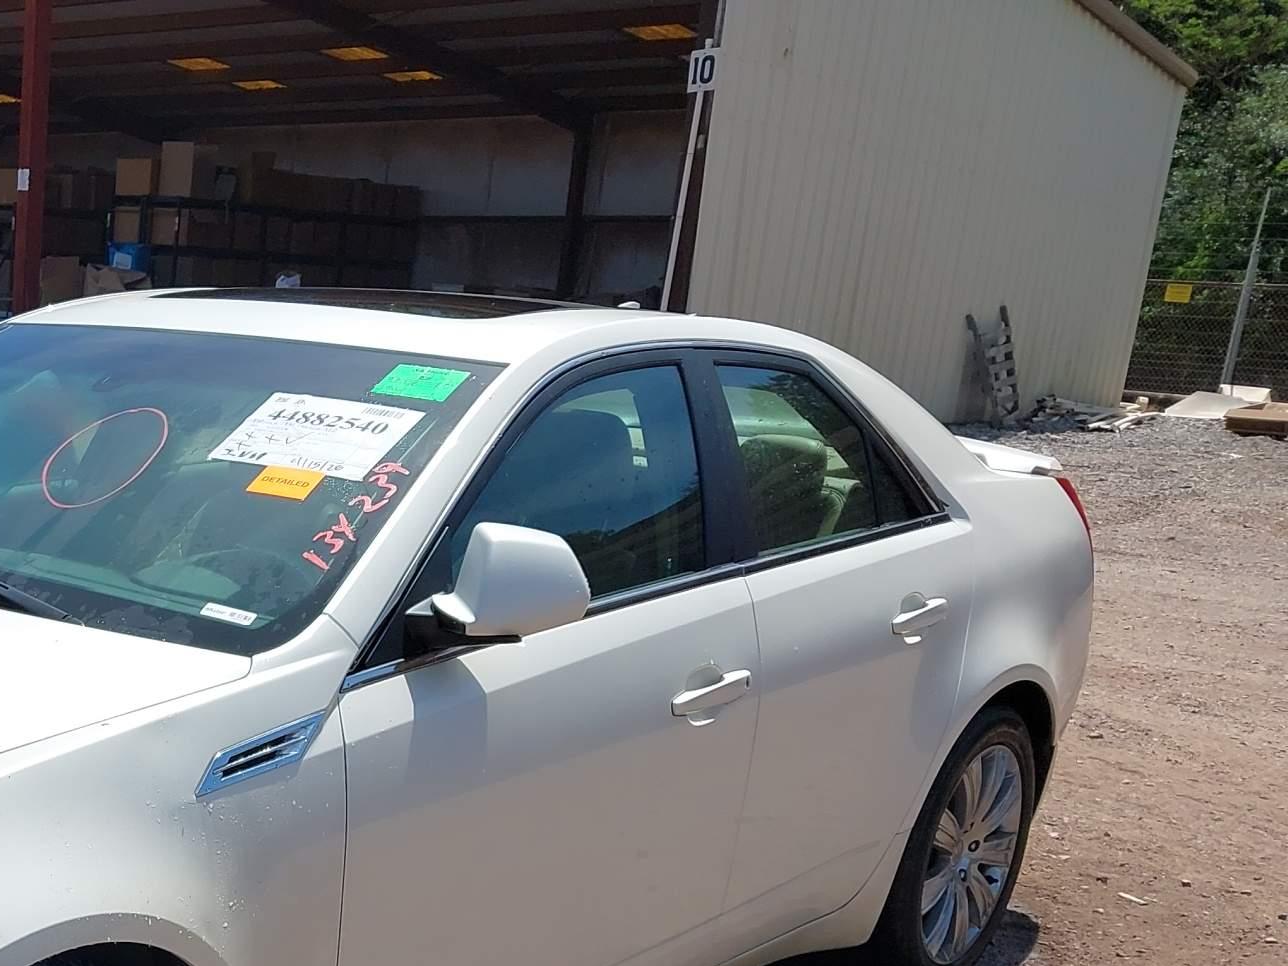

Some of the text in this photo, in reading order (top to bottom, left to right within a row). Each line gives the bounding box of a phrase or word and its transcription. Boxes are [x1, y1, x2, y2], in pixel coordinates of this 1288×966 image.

[691, 54, 716, 85] 10
[268, 407, 389, 435] 44882540
[261, 475, 311, 489] DETAILED
